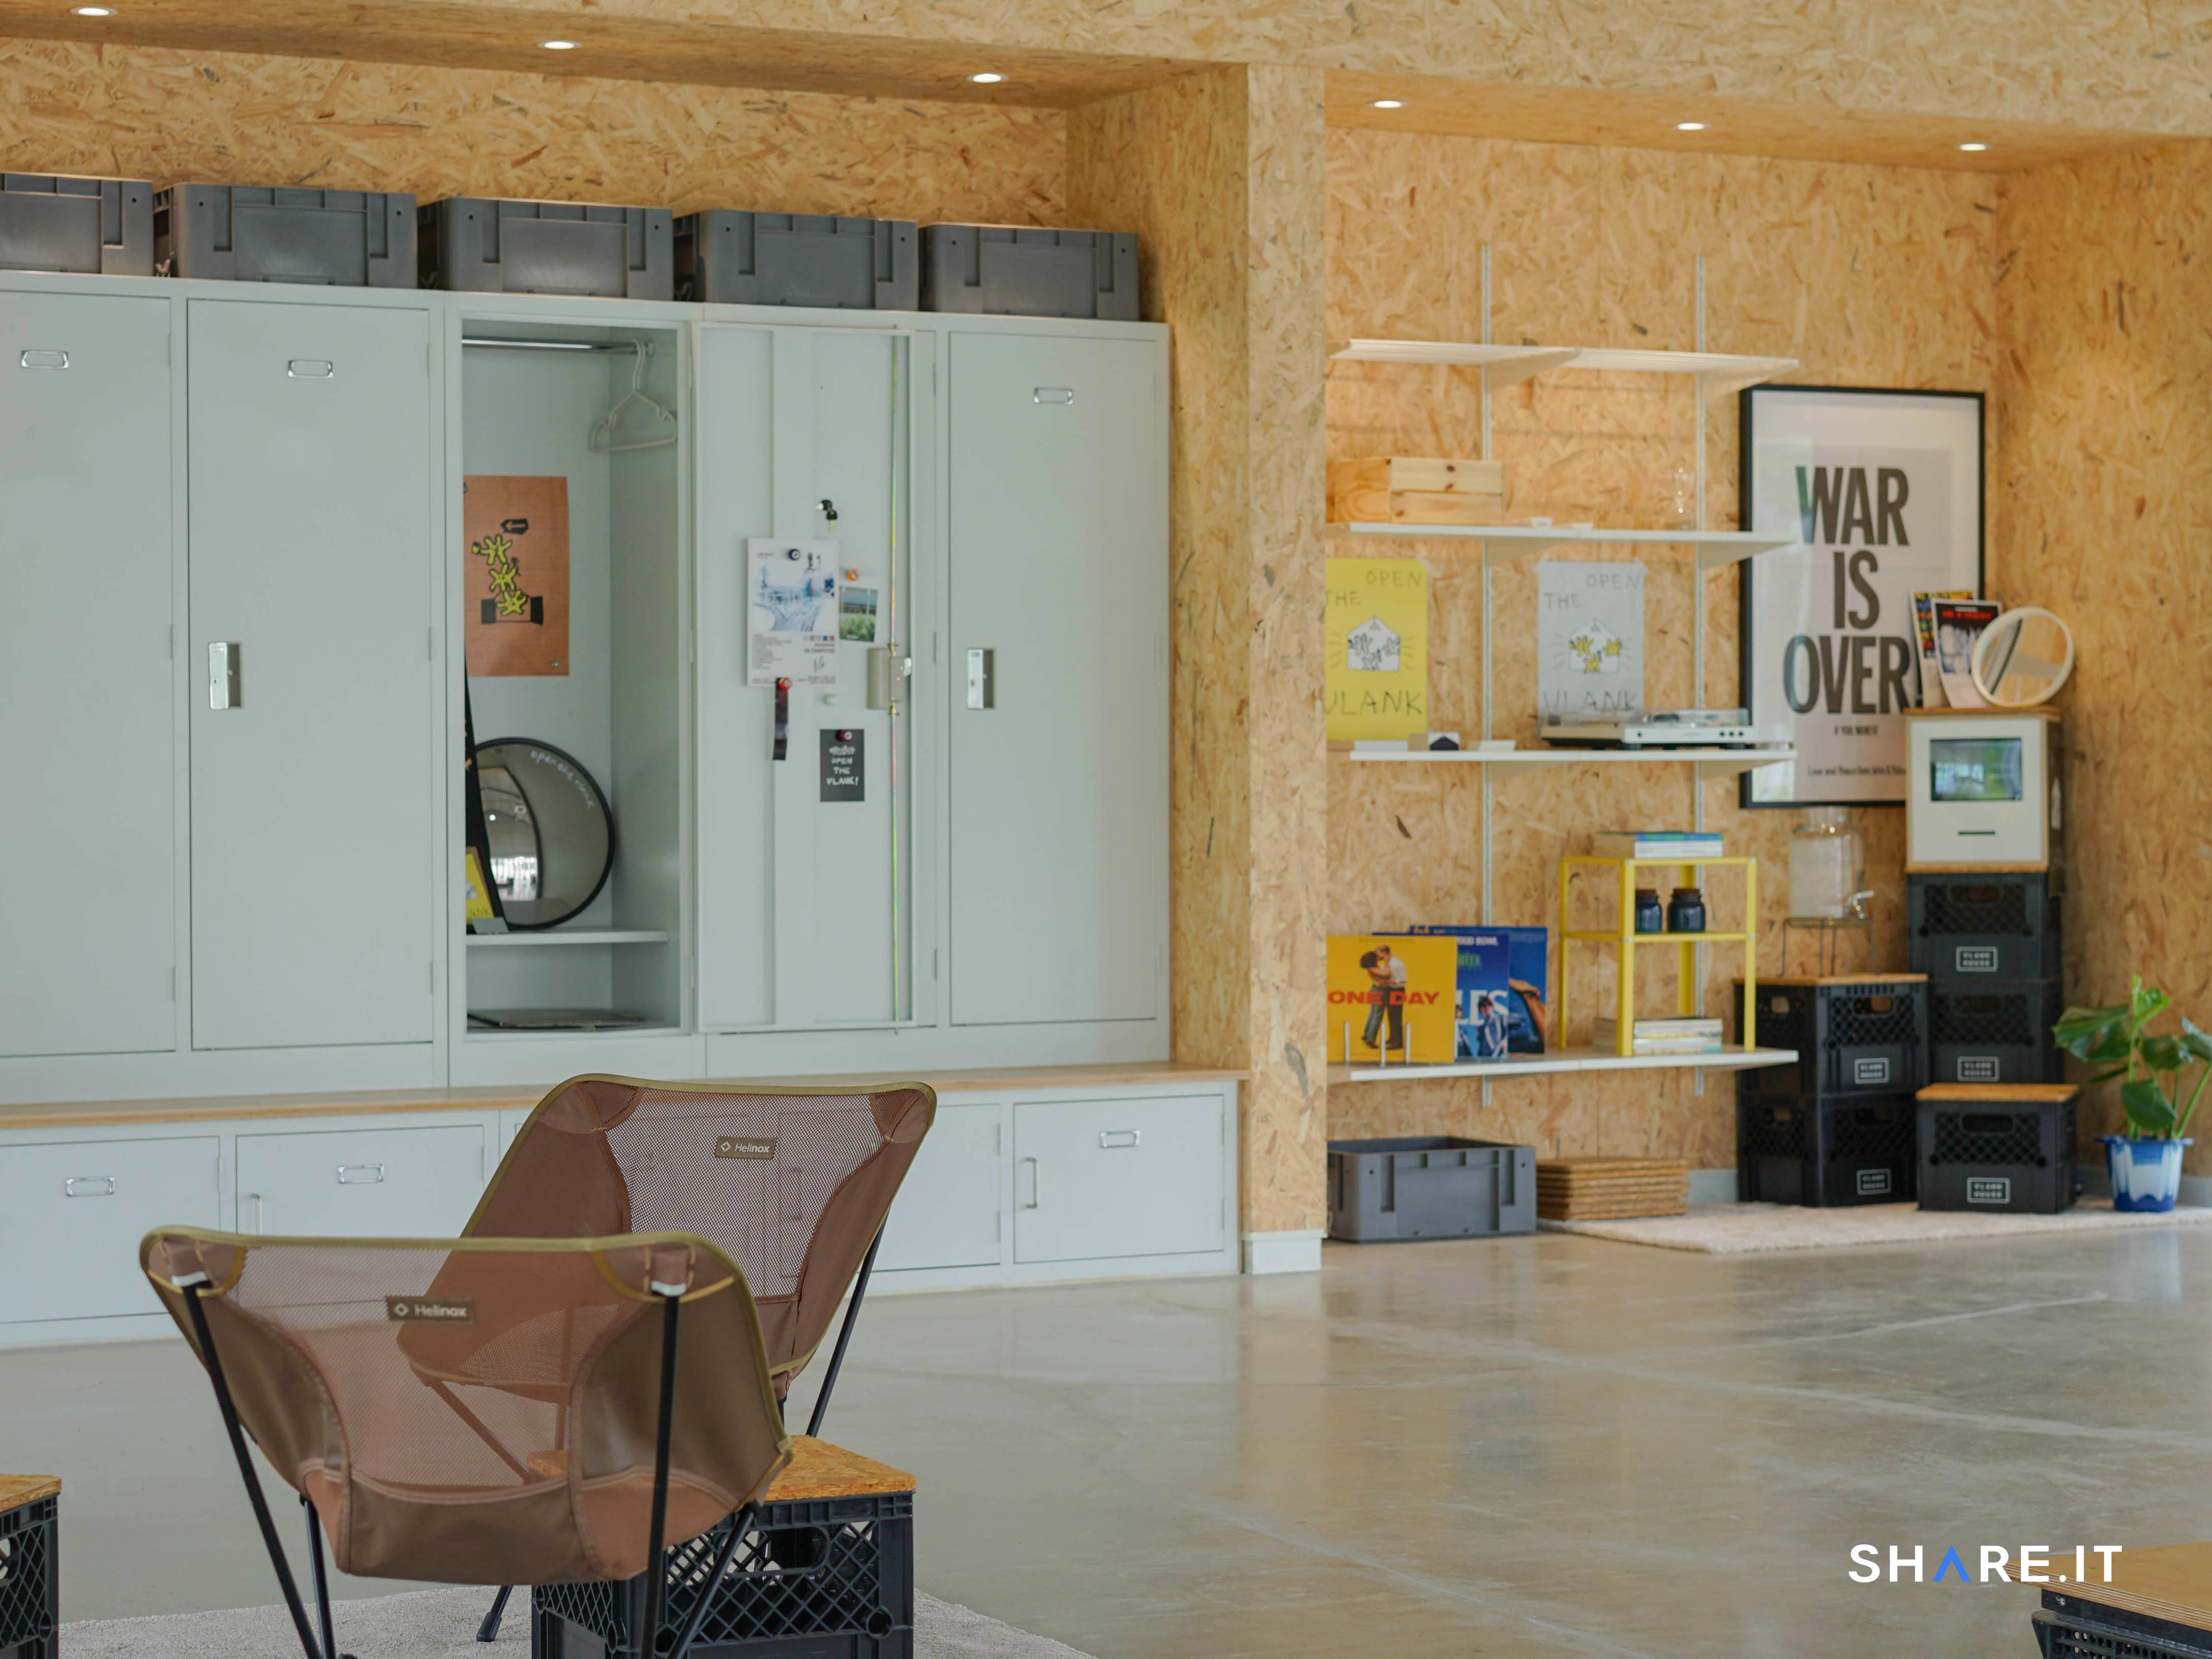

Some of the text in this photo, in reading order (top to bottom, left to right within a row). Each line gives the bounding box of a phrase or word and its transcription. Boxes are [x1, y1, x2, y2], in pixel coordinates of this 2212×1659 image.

[1795, 466, 1910, 546] WAR
[1366, 570, 1421, 587] OPEN
[1586, 572, 1640, 590] OPEN
[1325, 589, 1360, 608] THE
[1833, 550, 1879, 630] IS
[1543, 592, 1583, 609] THE
[1782, 635, 1911, 715] OVER
[1328, 991, 1440, 1005] ONE DAY
[734, 1143, 770, 1153] Helinox
[414, 1303, 468, 1318] Helinox
